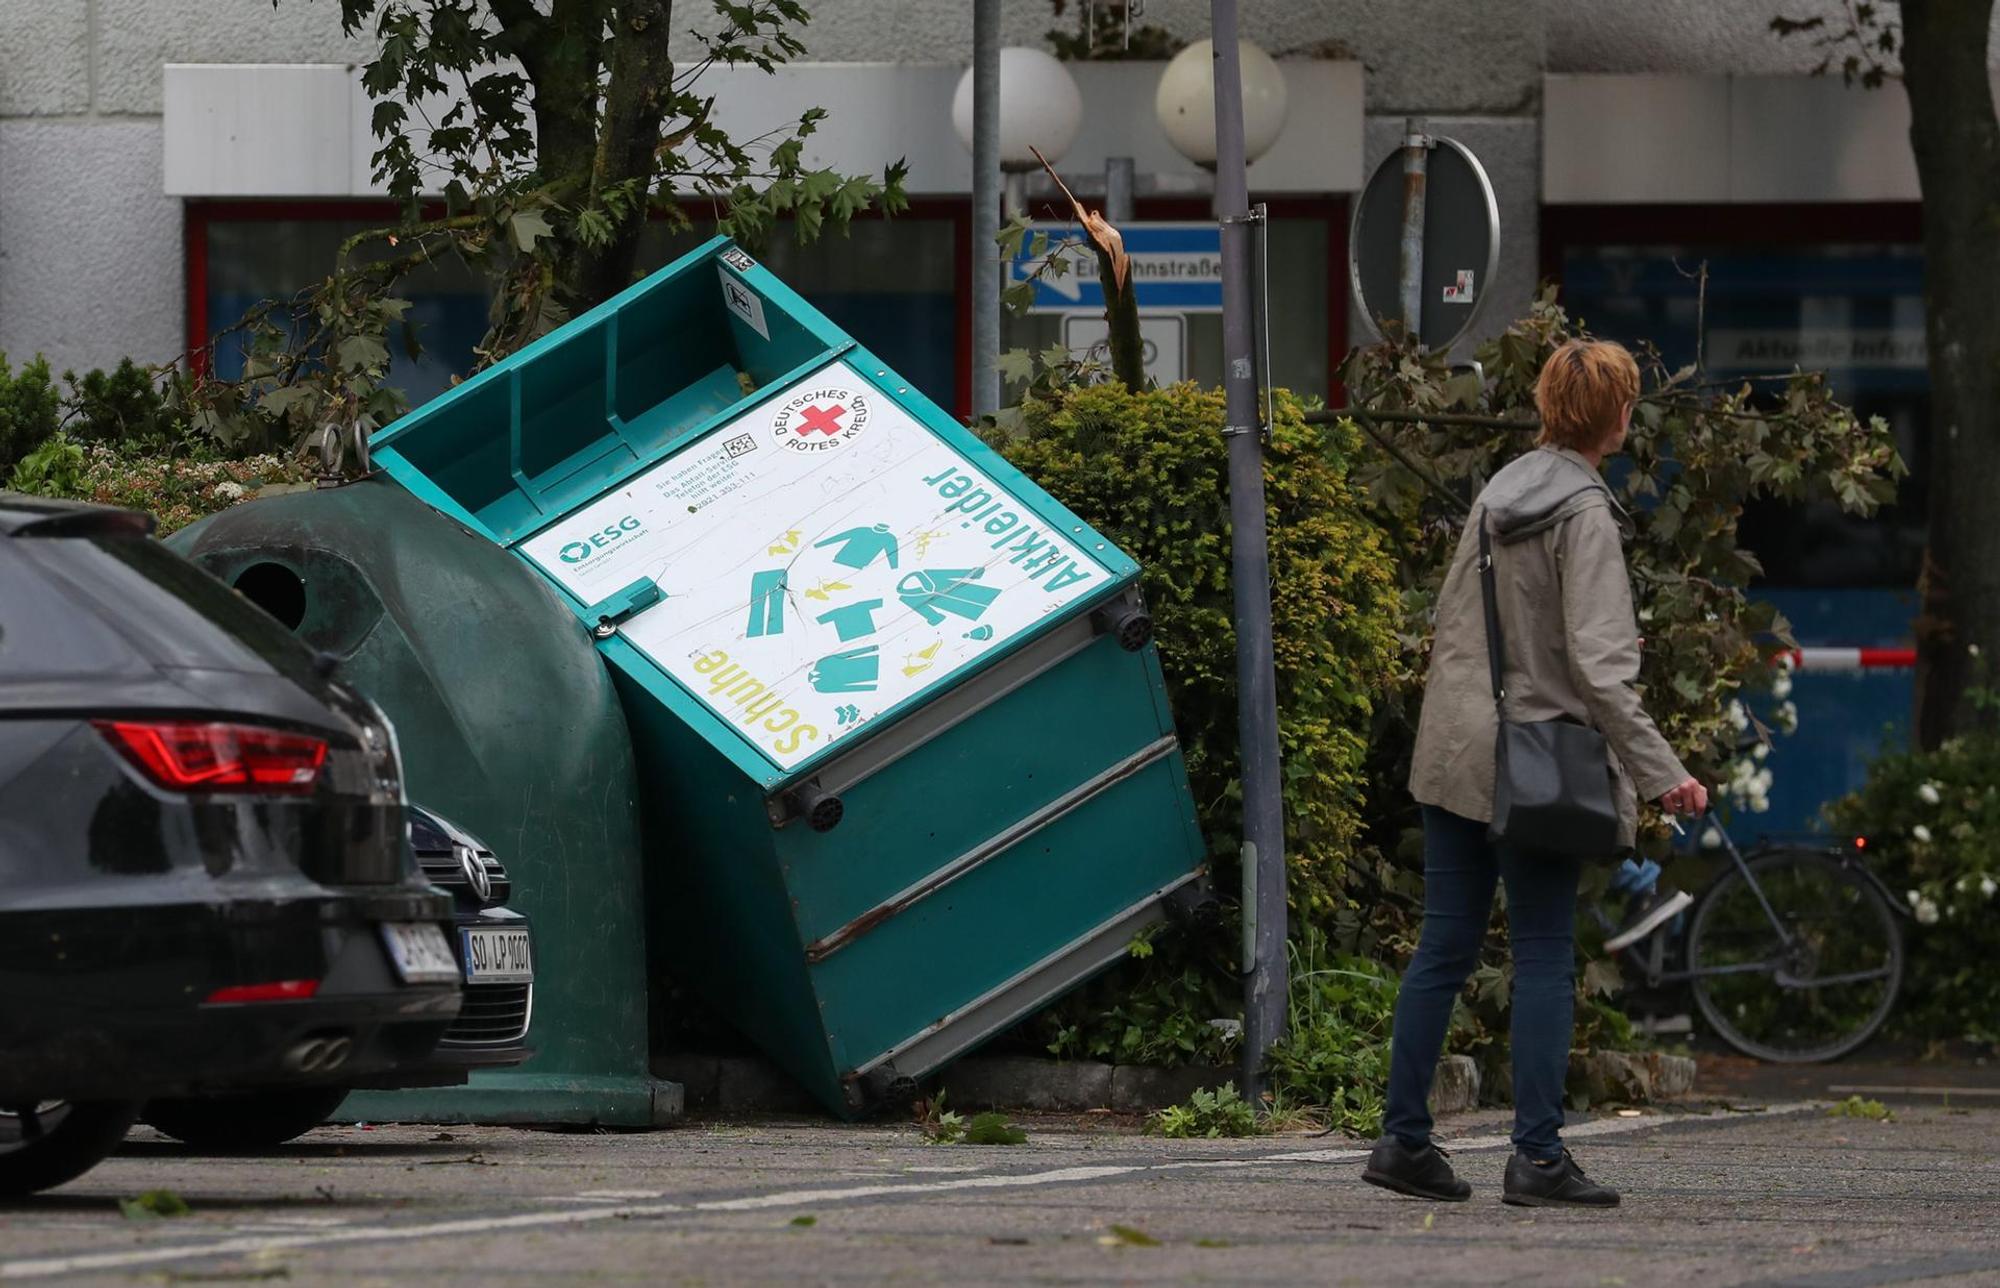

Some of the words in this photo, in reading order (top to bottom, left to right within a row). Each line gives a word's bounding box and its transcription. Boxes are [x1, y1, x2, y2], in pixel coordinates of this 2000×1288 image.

[1076, 257, 1221, 277] Eihnstraße
[774, 389, 848, 436] DEUTSCHES
[785, 438, 840, 451] ROTES
[671, 464, 698, 480] haben
[707, 471, 721, 482] der
[663, 487, 680, 498] Das
[589, 515, 641, 548] ESG
[922, 466, 1092, 593] Altkleider
[693, 650, 818, 754] Schuhe
[472, 935, 487, 970] SO
[492, 935, 506, 969] LP
